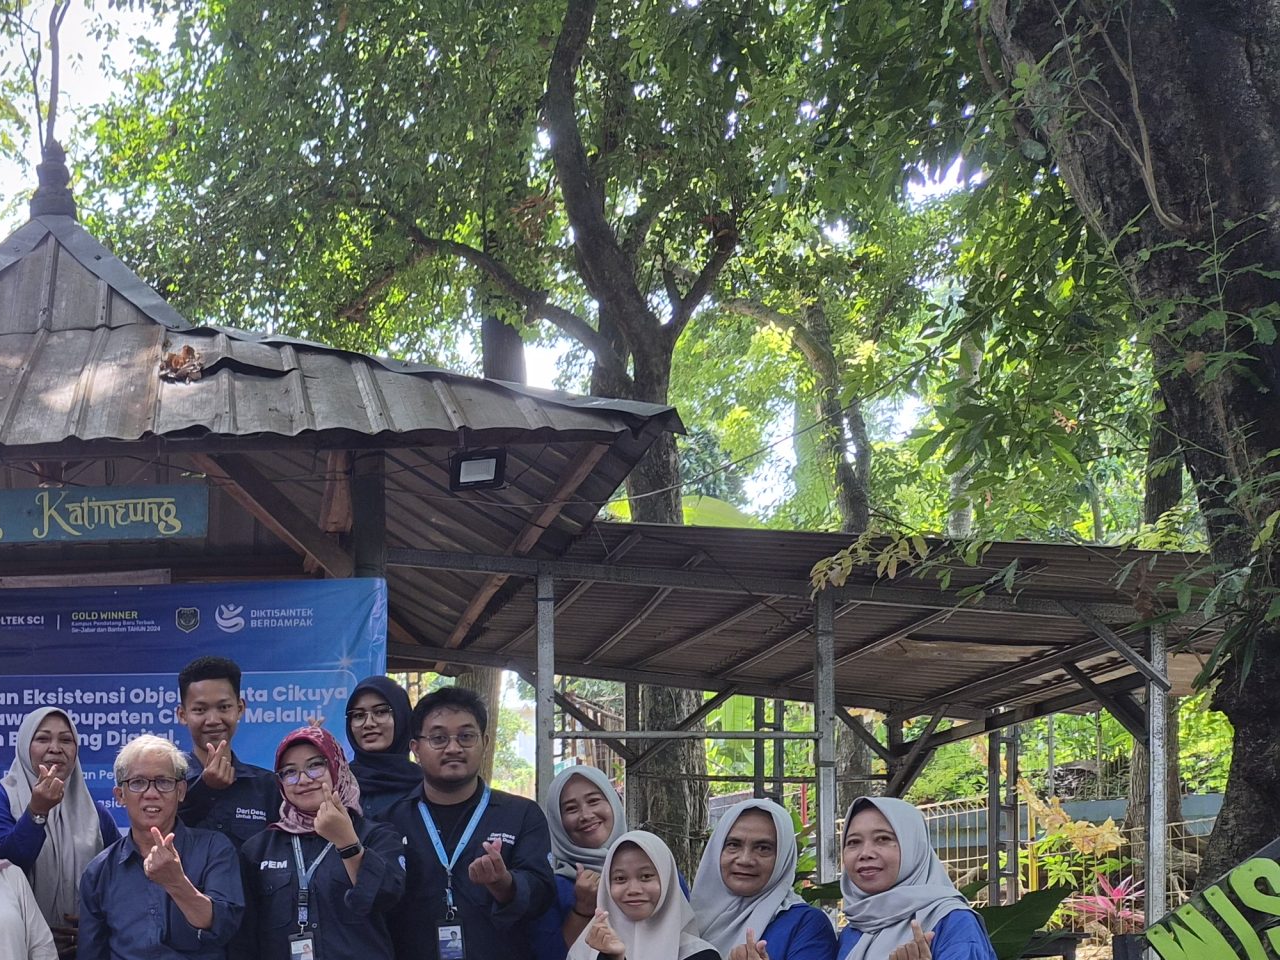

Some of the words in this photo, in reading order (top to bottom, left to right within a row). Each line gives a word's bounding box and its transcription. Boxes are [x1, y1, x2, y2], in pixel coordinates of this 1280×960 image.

[71, 612, 98, 620] GOLD
[100, 611, 138, 619] WINNER
[250, 608, 314, 617] DIKTISAINTEK
[26, 615, 44, 625] SCI
[250, 618, 313, 628] BERDAMPAK
[23, 687, 125, 705] Eksistensi
[272, 684, 348, 706] Cikuya
[260, 859, 288, 870] PEM
